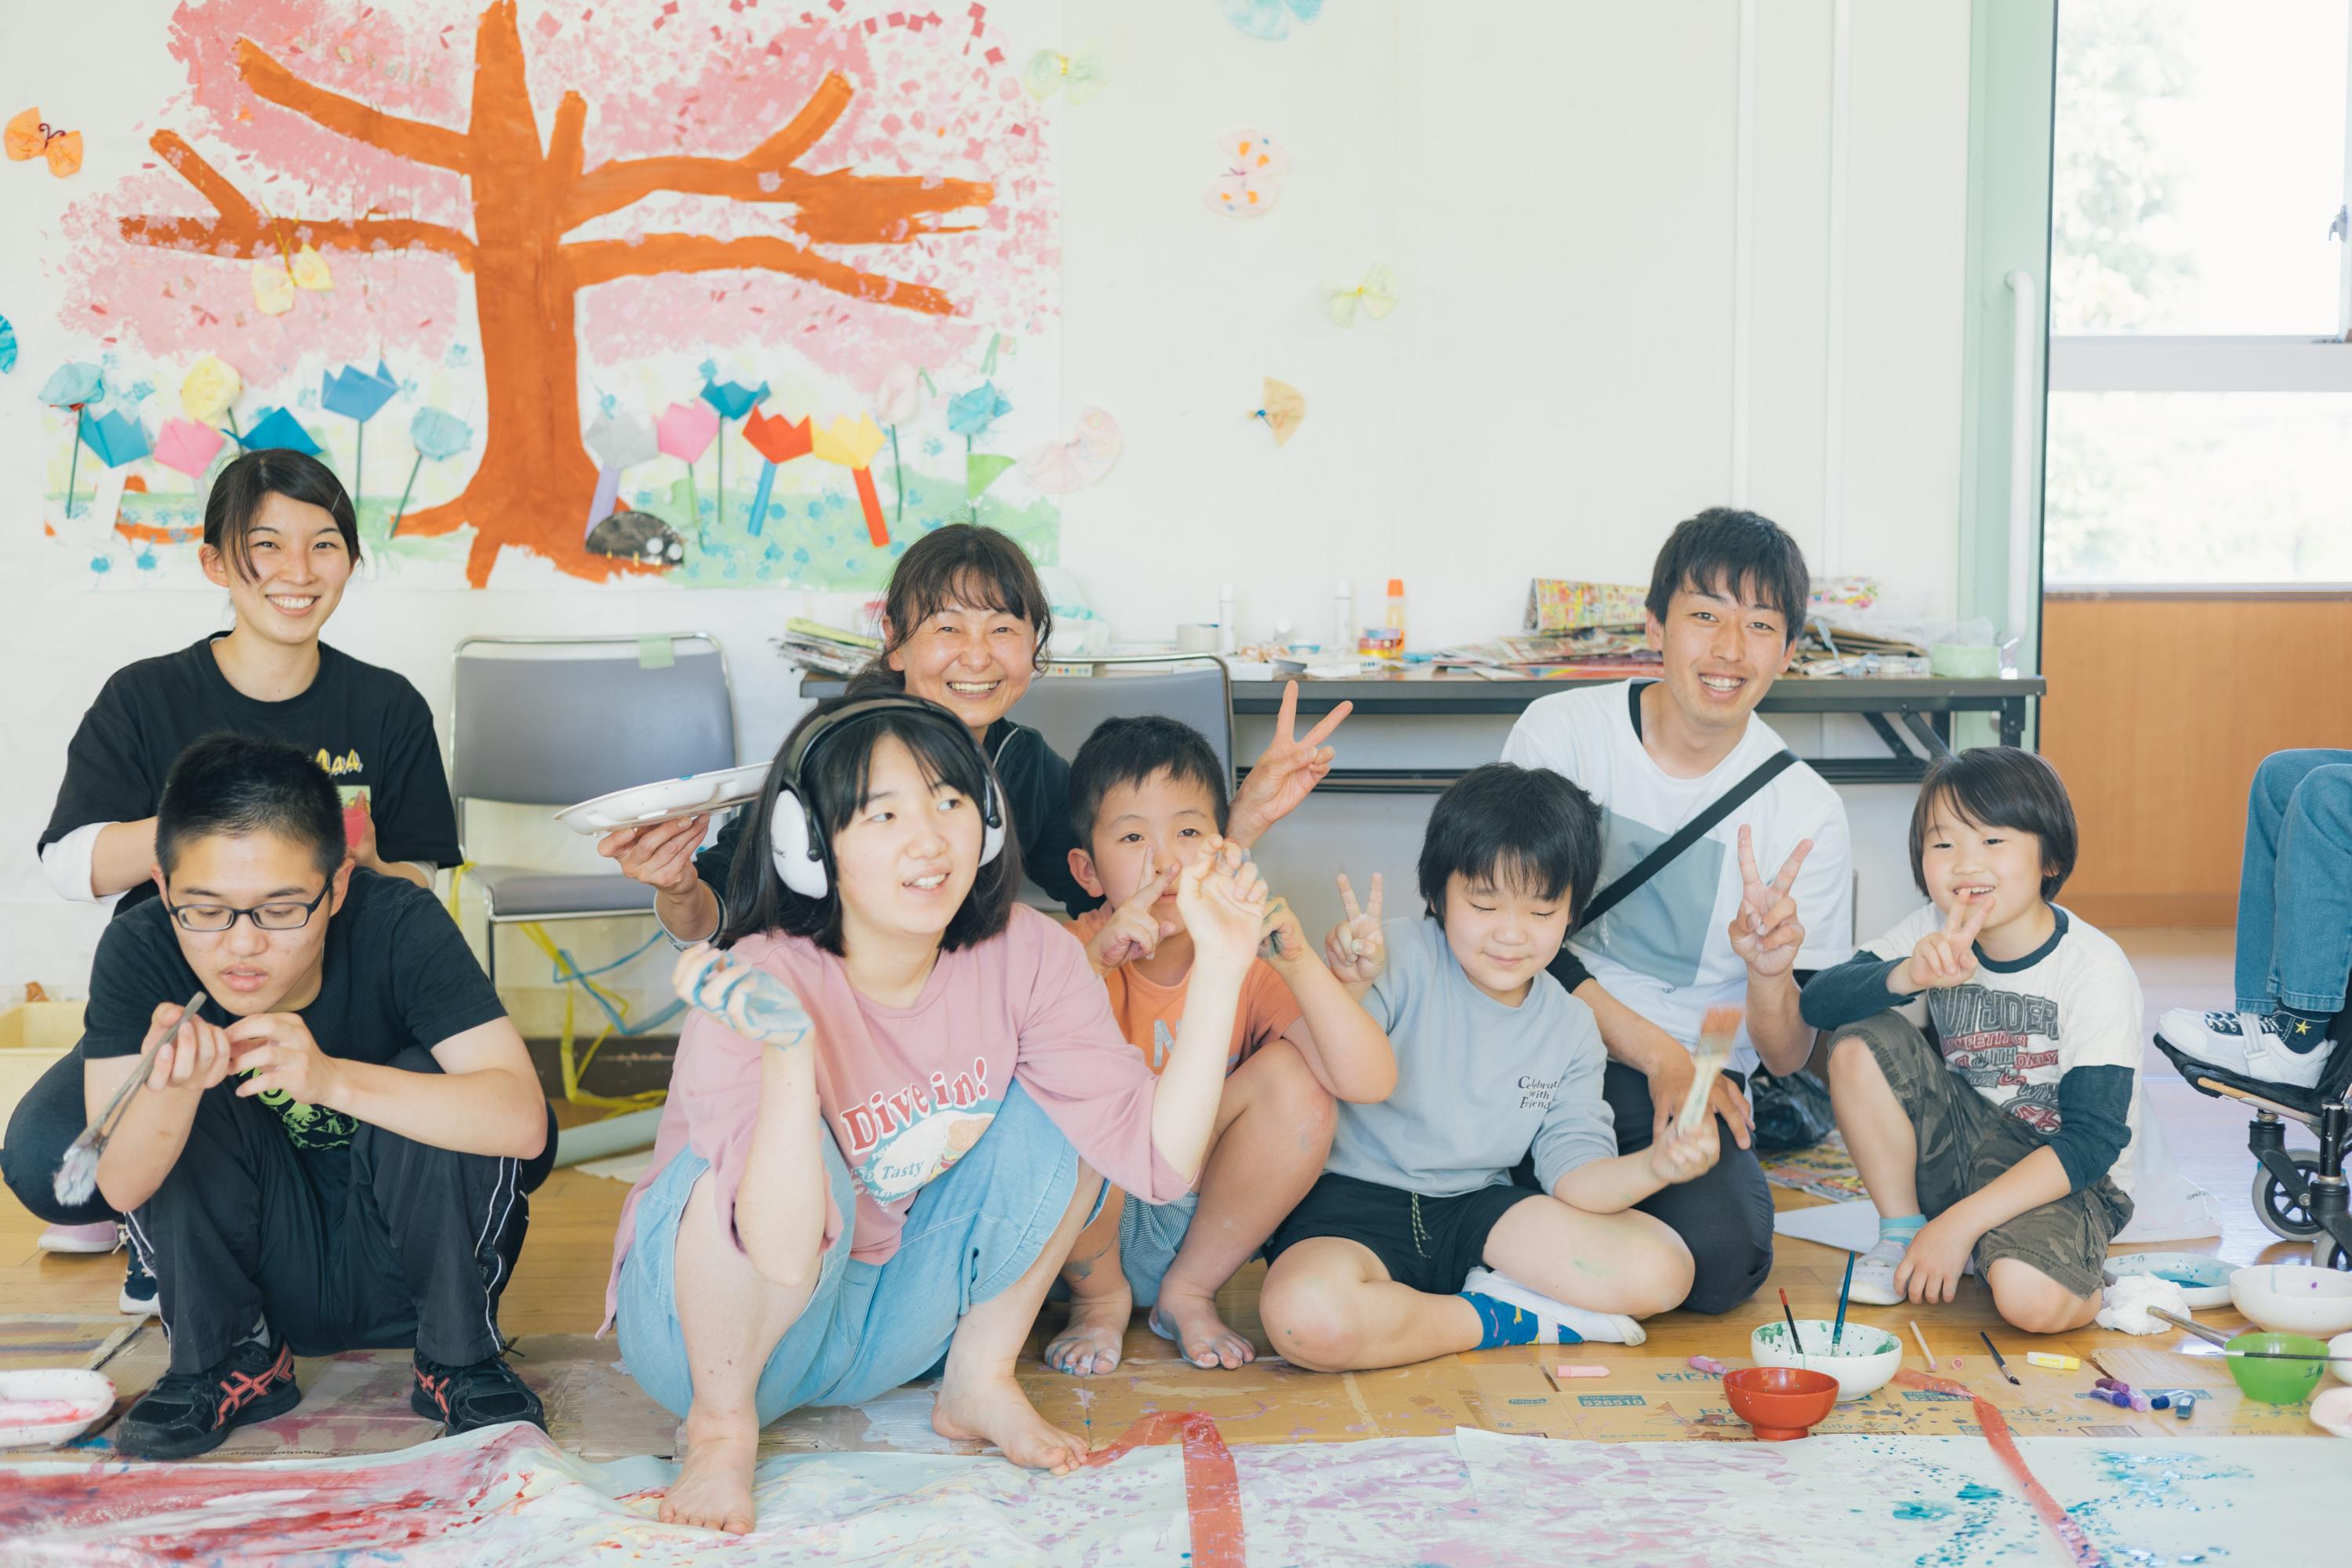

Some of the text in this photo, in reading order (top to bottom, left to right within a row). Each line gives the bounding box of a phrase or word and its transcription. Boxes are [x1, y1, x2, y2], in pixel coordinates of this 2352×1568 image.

[1530, 1090, 1549, 1100] with
[840, 1056, 989, 1156] Dive in!
[882, 1160, 924, 1181] Tasty
